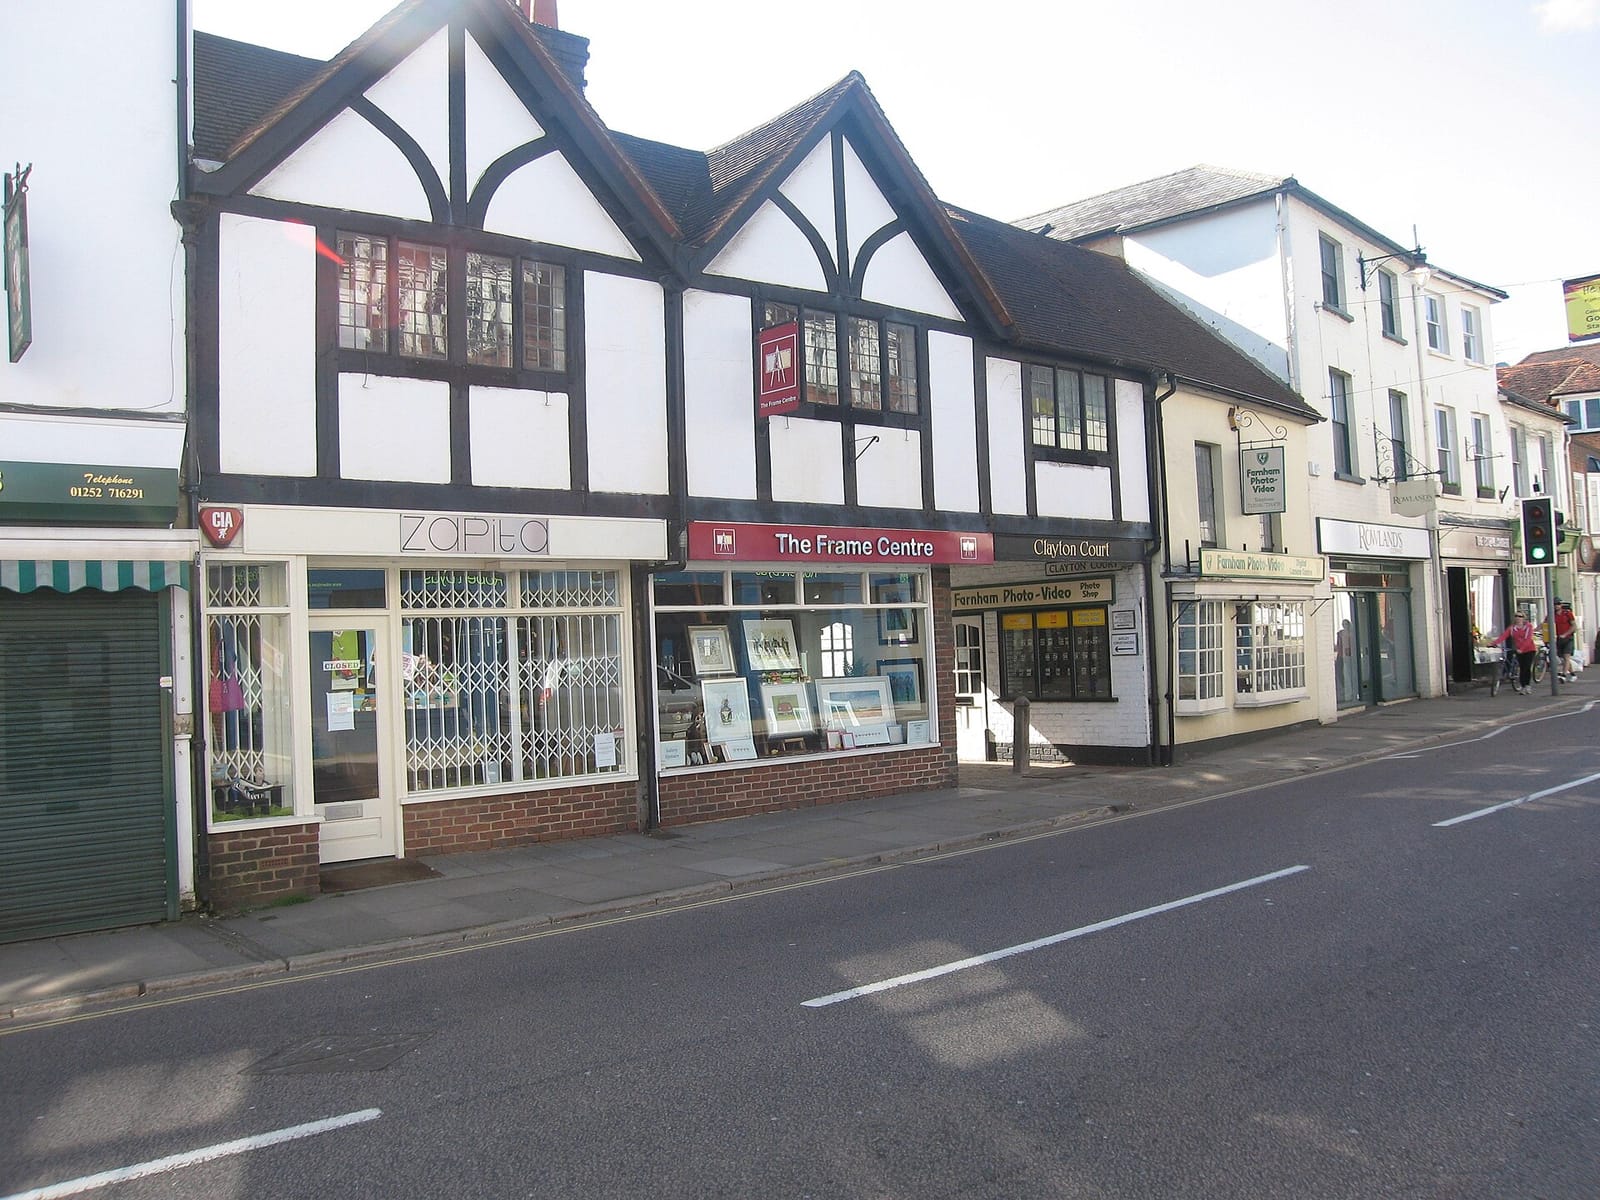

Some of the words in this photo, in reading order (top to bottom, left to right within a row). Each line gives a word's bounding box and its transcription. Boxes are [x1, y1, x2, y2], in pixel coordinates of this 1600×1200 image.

[1246, 468, 1280, 478] Farnham
[83, 473, 134, 485] Telephone
[1250, 477, 1278, 485] Photo-
[70, 487, 102, 498] 01252
[108, 488, 144, 499] 716291
[1252, 485, 1276, 493] Video
[211, 511, 233, 528] CIA
[774, 532, 812, 554] The
[815, 534, 873, 556] Frame
[876, 536, 934, 557] Centre
[1033, 538, 1076, 559] Clayton
[1079, 540, 1110, 558] Court
[1049, 562, 1087, 573] CLAYTON
[1217, 554, 1246, 570] Farnham
[1079, 582, 1101, 590] Photo
[954, 592, 998, 607] Farnham
[1082, 590, 1099, 599] Shop
[324, 661, 359, 670] CLOSED
